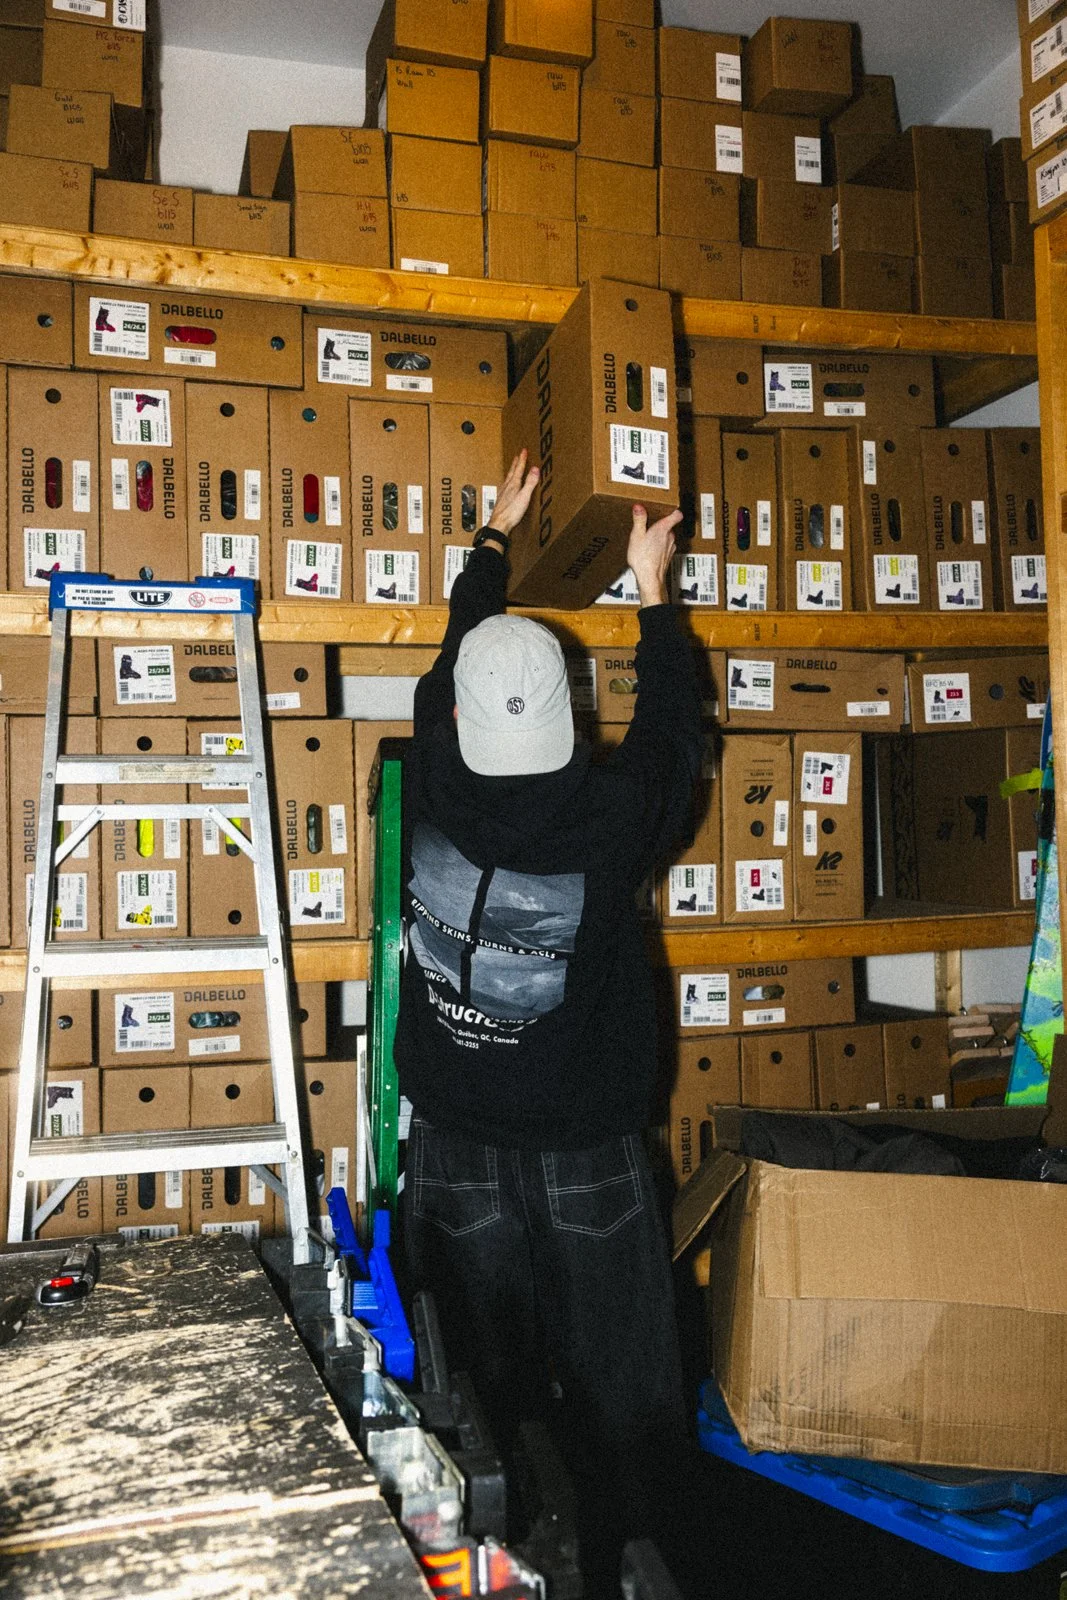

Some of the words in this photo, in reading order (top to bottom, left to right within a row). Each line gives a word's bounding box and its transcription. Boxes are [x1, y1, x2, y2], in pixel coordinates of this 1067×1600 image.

[160, 303, 224, 320] DALBELLO
[379, 331, 437, 346] DALBELLO
[604, 352, 617, 413] DALBELLO
[818, 363, 870, 374] DALBELLO
[537, 352, 553, 548] DALBELLO
[633, 431, 641, 453] 25/25.5
[22, 447, 34, 514] DALBELLO
[162, 458, 175, 519] DALBELLO
[199, 461, 211, 522] DALBELLO
[282, 468, 293, 528] DALBELLO
[362, 475, 373, 537] DALBELLO
[441, 477, 452, 535] DALBELLO
[794, 499, 804, 551] DALBELLO
[871, 493, 882, 545] DALBELLO
[933, 495, 945, 550] DALBELLO
[1006, 494, 1018, 546] DALBELLO
[562, 536, 609, 581] DALBELLO
[136, 592, 165, 603] LITE
[148, 667, 170, 675] 25/25.5
[786, 658, 837, 671] DALBELLO
[744, 785, 773, 804] K2
[24, 799, 35, 863] DALBELLO
[114, 799, 125, 861] DALBEO
[285, 799, 298, 861] DALBELLO
[139, 874, 148, 896] 26/26.5
[815, 851, 843, 870] K2
[411, 898, 440, 928] RIPPING
[442, 924, 475, 945] SKINS,
[478, 938, 513, 953] TURNS
[530, 950, 556, 960] ACLS
[184, 989, 246, 1002] DALBELLO
[736, 965, 788, 979] DALBELLO
[480, 1034, 492, 1042] QC,
[493, 1036, 519, 1045] Canada
[681, 1117, 692, 1174] DALBELLO
